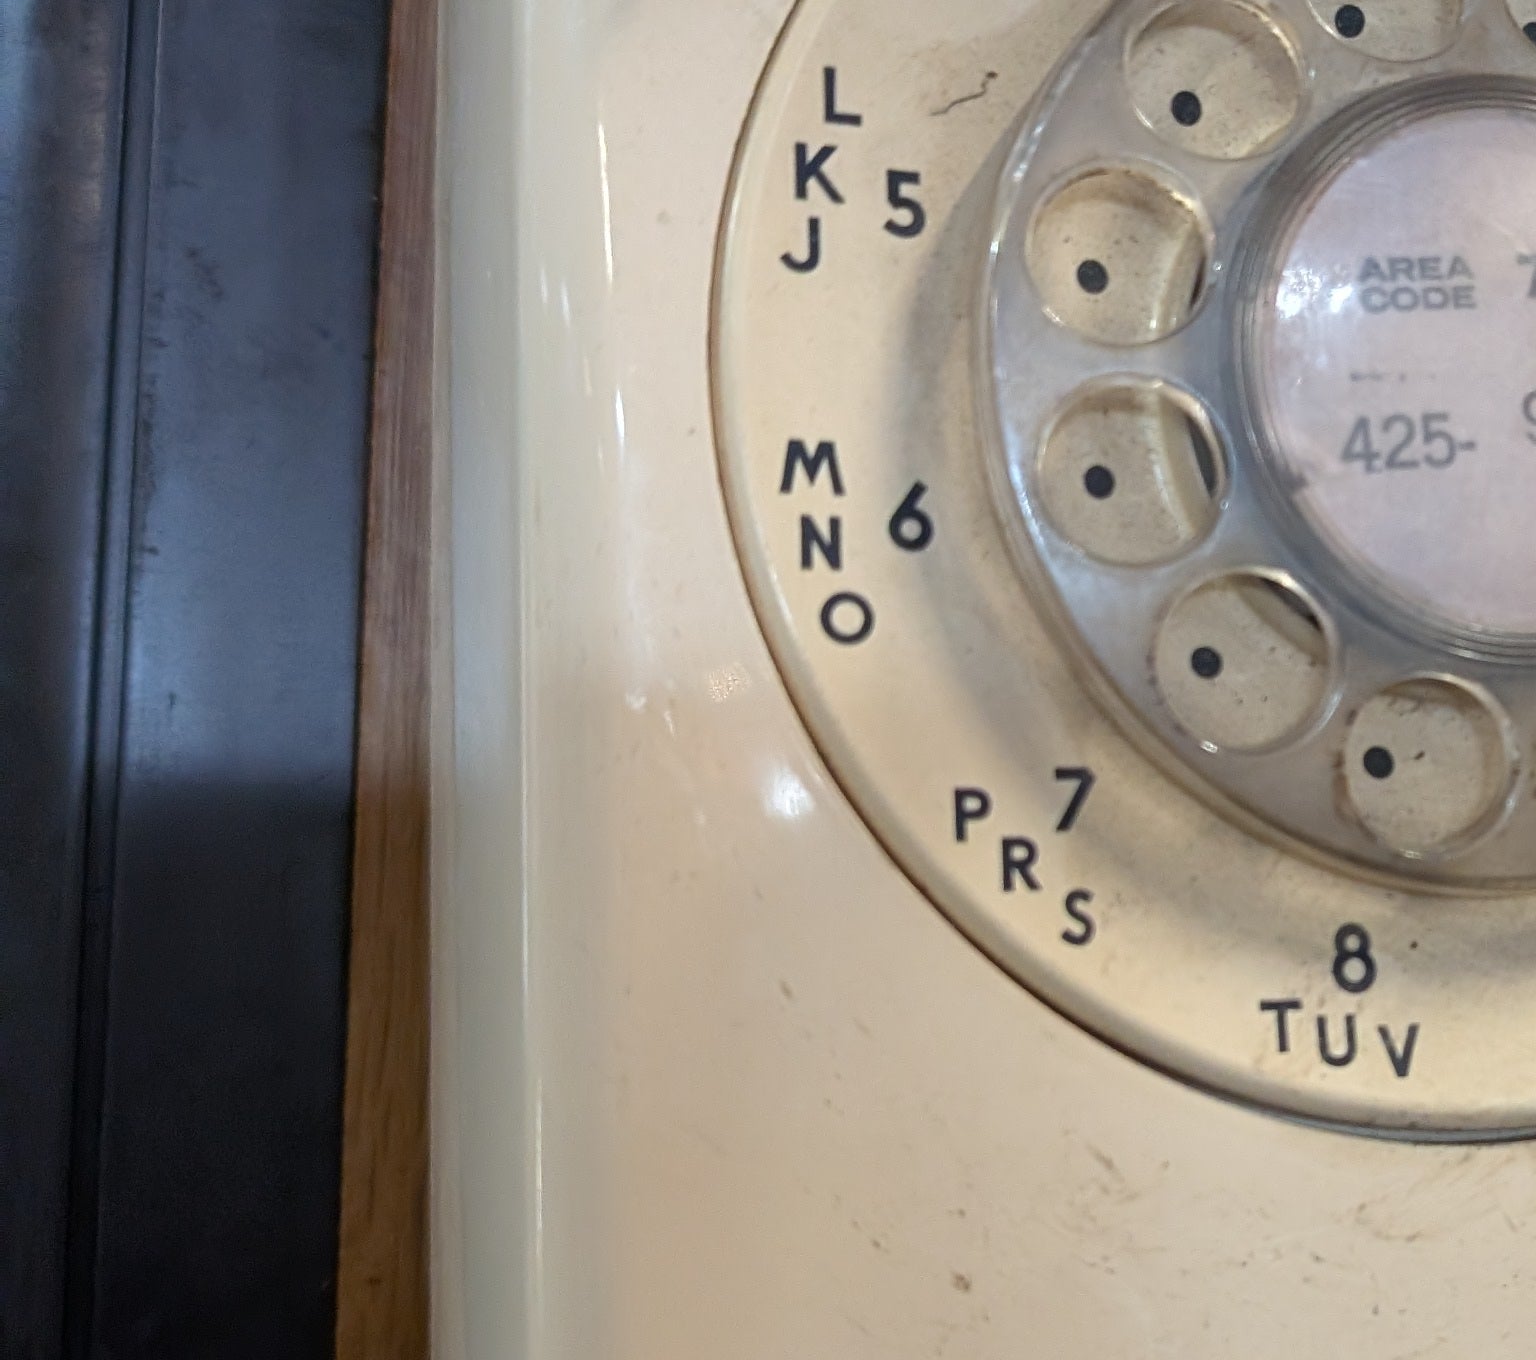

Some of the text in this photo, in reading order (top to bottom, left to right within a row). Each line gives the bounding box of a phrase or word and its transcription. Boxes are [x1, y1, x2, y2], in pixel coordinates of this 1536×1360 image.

[884, 170, 926, 238] 5
[1358, 255, 1474, 283] AREA
[1360, 285, 1478, 313] CODE
[1340, 412, 1478, 474] 425-
[889, 481, 934, 552] 6
[1054, 767, 1096, 832] 7
[1331, 923, 1376, 993] 8
[1260, 999, 1419, 1078] TUV
